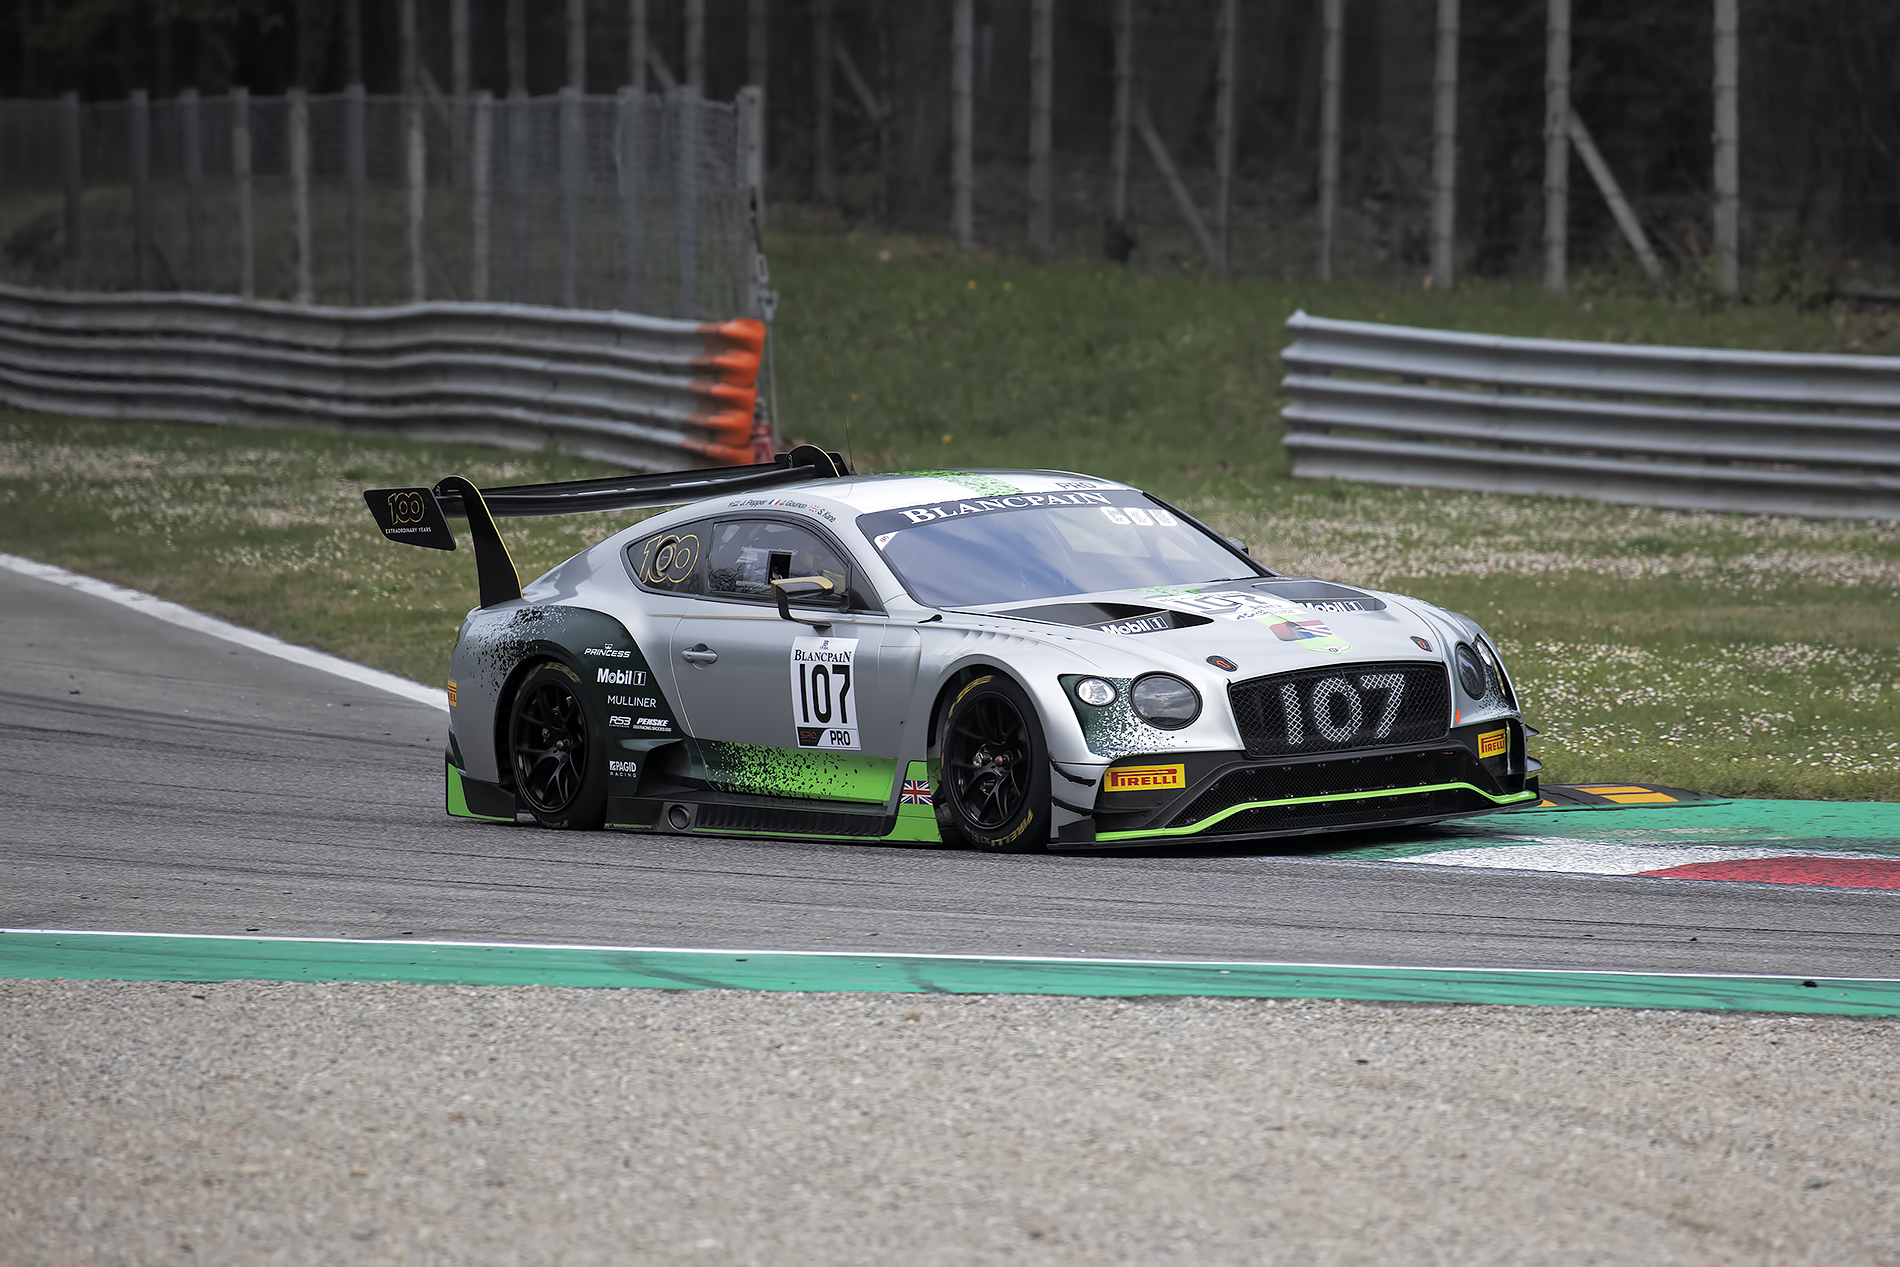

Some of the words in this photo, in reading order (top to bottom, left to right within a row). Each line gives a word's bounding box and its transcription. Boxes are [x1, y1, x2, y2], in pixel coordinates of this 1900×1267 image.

[388, 491, 425, 525] 100
[898, 492, 1112, 525] BLANCPAIN
[1100, 620, 1152, 636] Mobil
[584, 648, 632, 659] PRINCESS
[794, 649, 852, 663] BLANCPAIN
[597, 667, 633, 685] Mobil
[607, 694, 657, 708] MULLINER
[799, 664, 851, 724] 107
[1280, 673, 1406, 745] 107
[636, 717, 669, 726] PENSKE
[829, 730, 851, 746] PRO
[1481, 733, 1505, 753] PIRELLI
[615, 761, 637, 773] PAGID
[1111, 768, 1178, 787] PIRELLI
